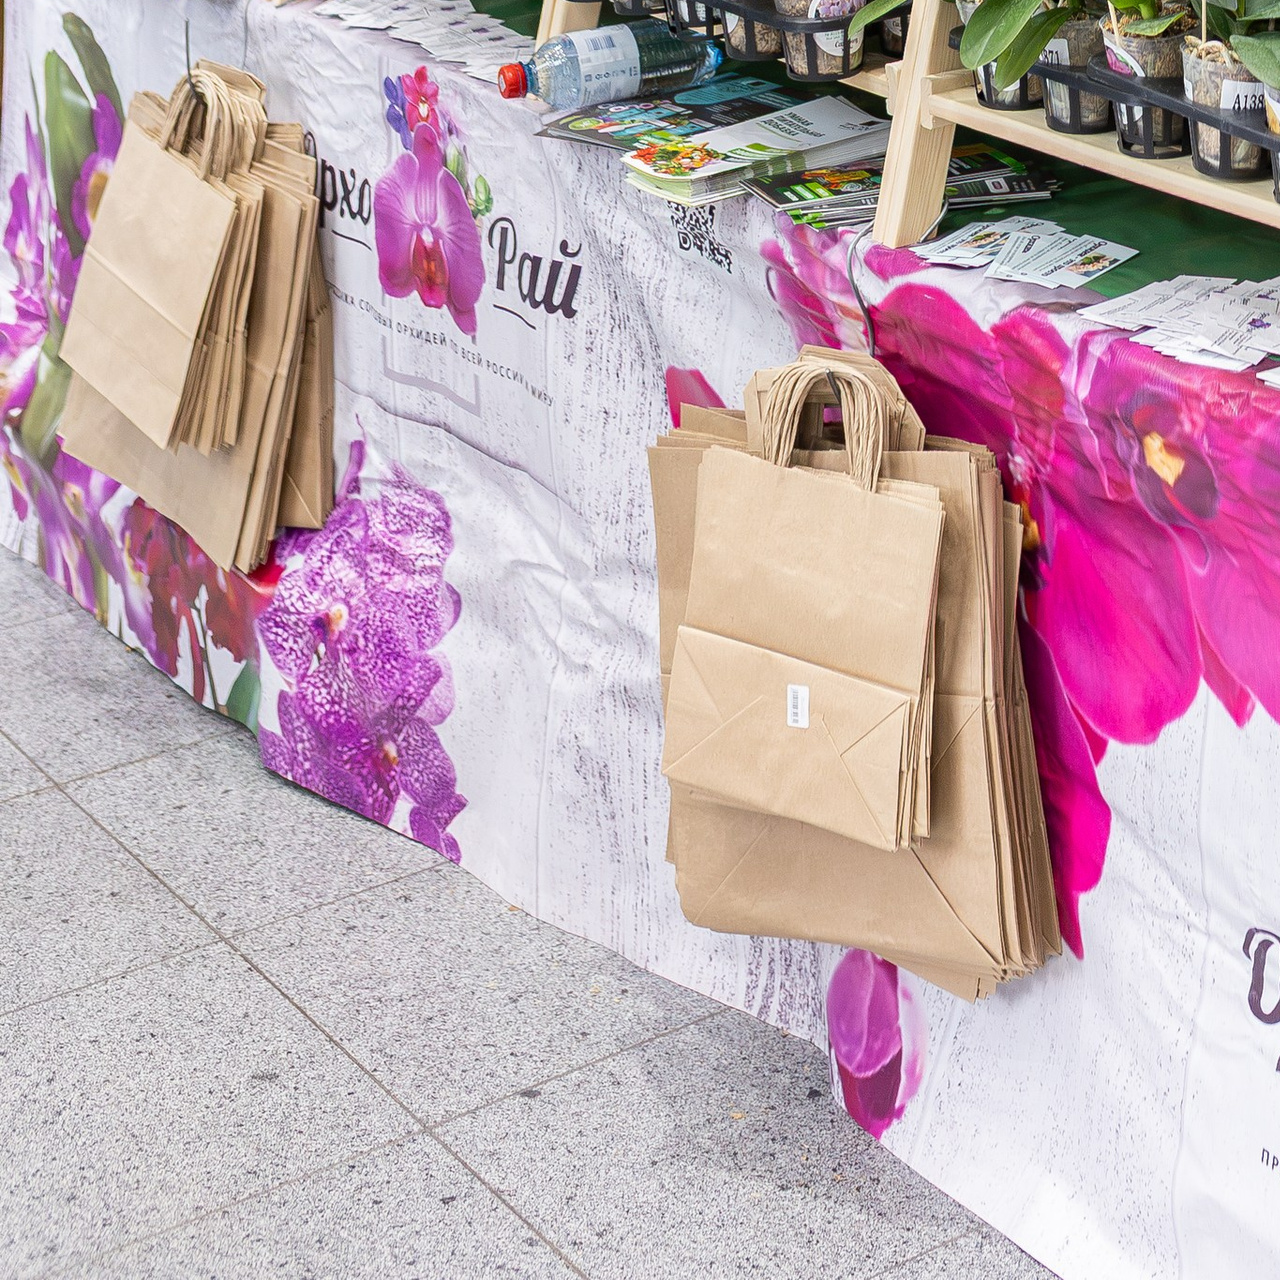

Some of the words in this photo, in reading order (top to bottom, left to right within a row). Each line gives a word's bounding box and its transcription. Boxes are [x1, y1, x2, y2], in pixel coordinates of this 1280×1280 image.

[1039, 49, 1061, 66] 871
[488, 216, 583, 320] Рай
[396, 321, 448, 349] ОРХИДЕЙ
[461, 346, 484, 369] ВСЕЙ
